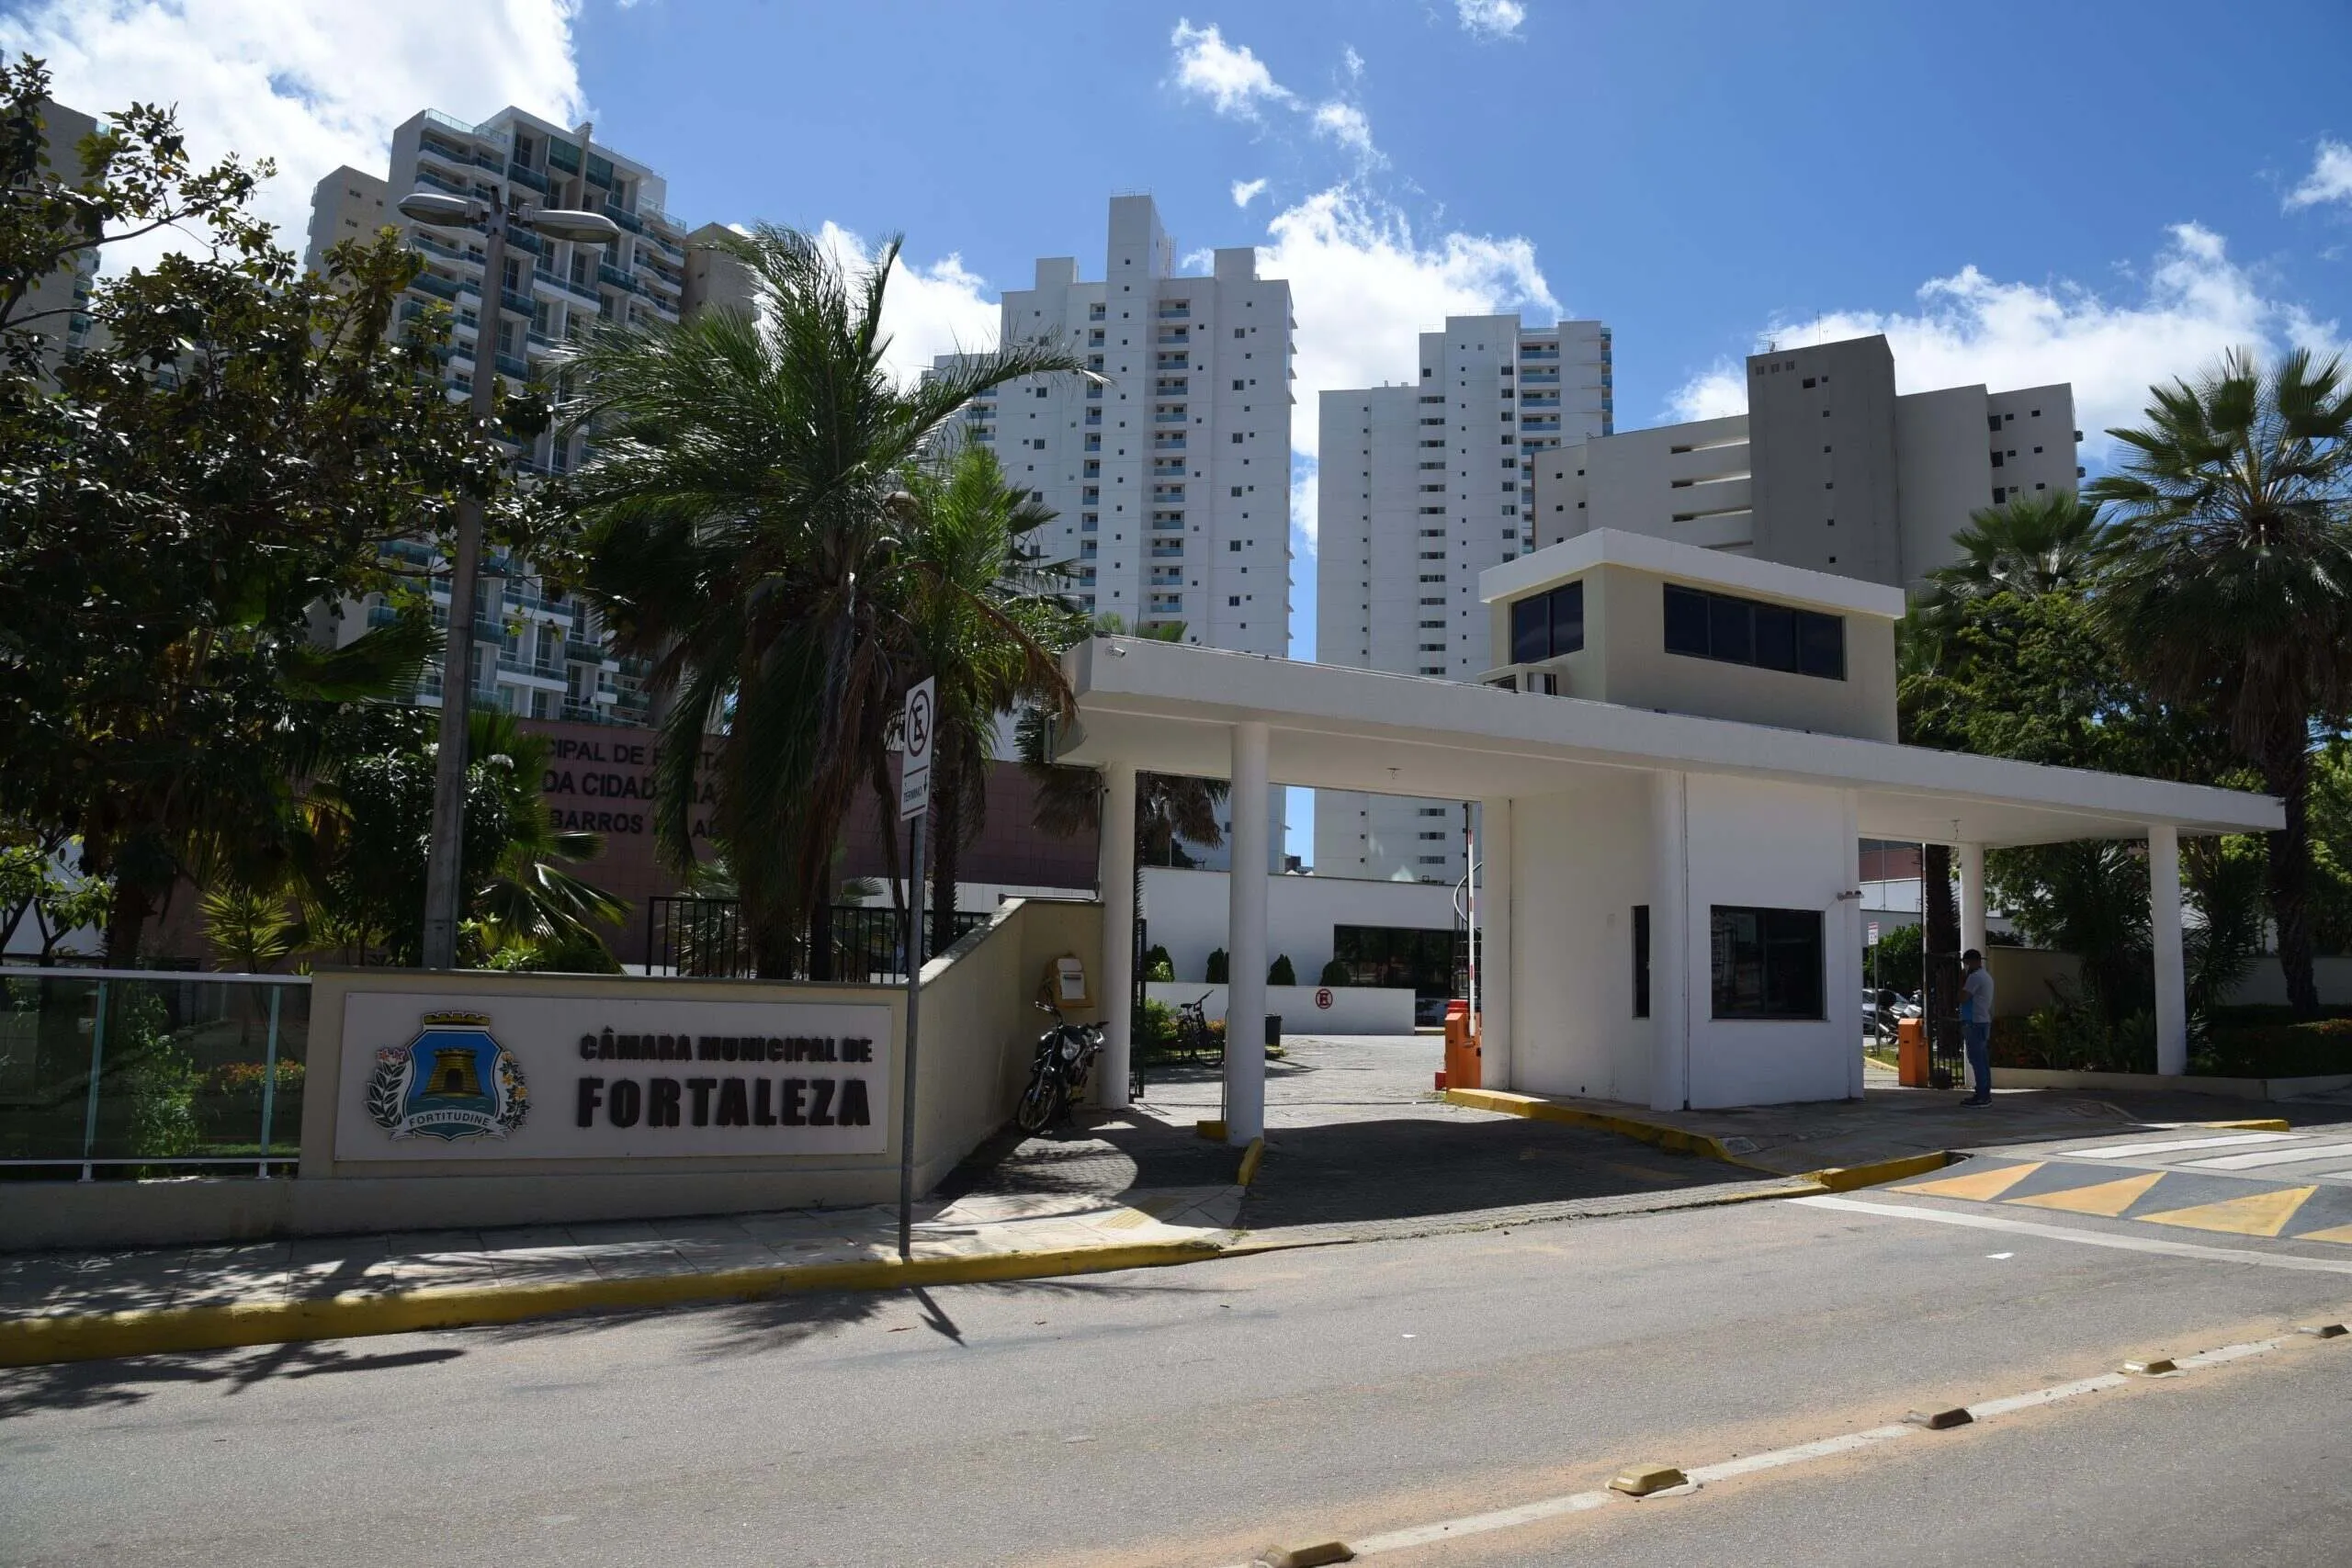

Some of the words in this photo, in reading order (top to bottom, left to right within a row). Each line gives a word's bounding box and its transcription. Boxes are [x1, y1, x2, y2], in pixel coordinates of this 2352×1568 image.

[614, 744, 644, 765] DE
[550, 809, 643, 832] BARROS
[580, 1027, 693, 1062] CÂMARA
[698, 1036, 838, 1064] MUNICIPAL
[842, 1037, 874, 1063] DE
[576, 1076, 871, 1128] FORTALEZA
[408, 1111, 491, 1127] FORTITUDINE
